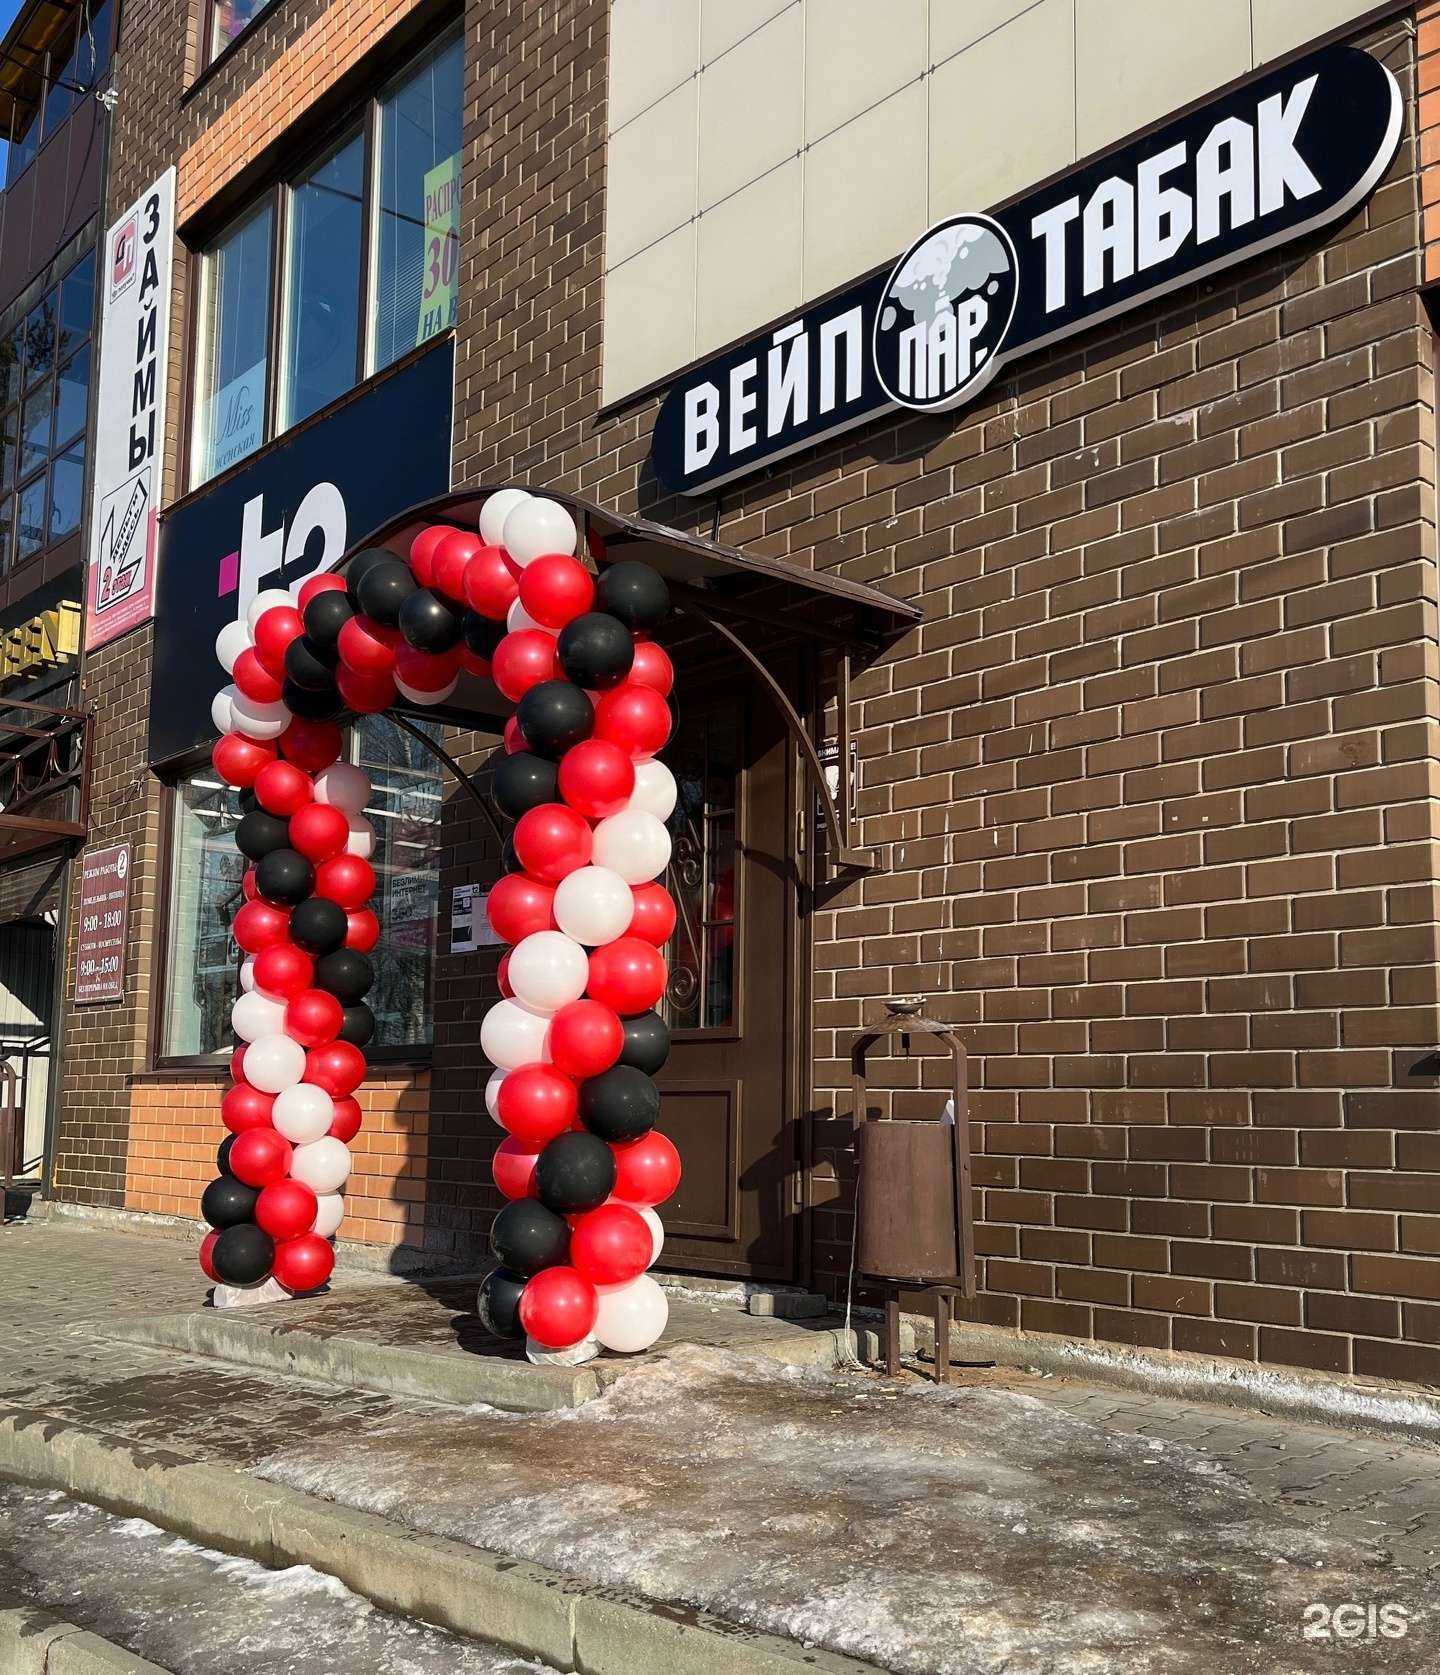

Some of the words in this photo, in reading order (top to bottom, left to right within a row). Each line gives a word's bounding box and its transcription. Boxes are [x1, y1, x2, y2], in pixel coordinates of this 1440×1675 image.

[1031, 73, 1322, 313] ТАБАК
[128, 193, 160, 473] ЗАЙМЫ
[684, 305, 863, 476] ВЕЙП
[101, 566, 112, 603] 2
[118, 853, 126, 871] 2
[83, 915, 99, 933] 9:00
[103, 910, 122, 929] 18:00
[80, 959, 95, 977] 9:00
